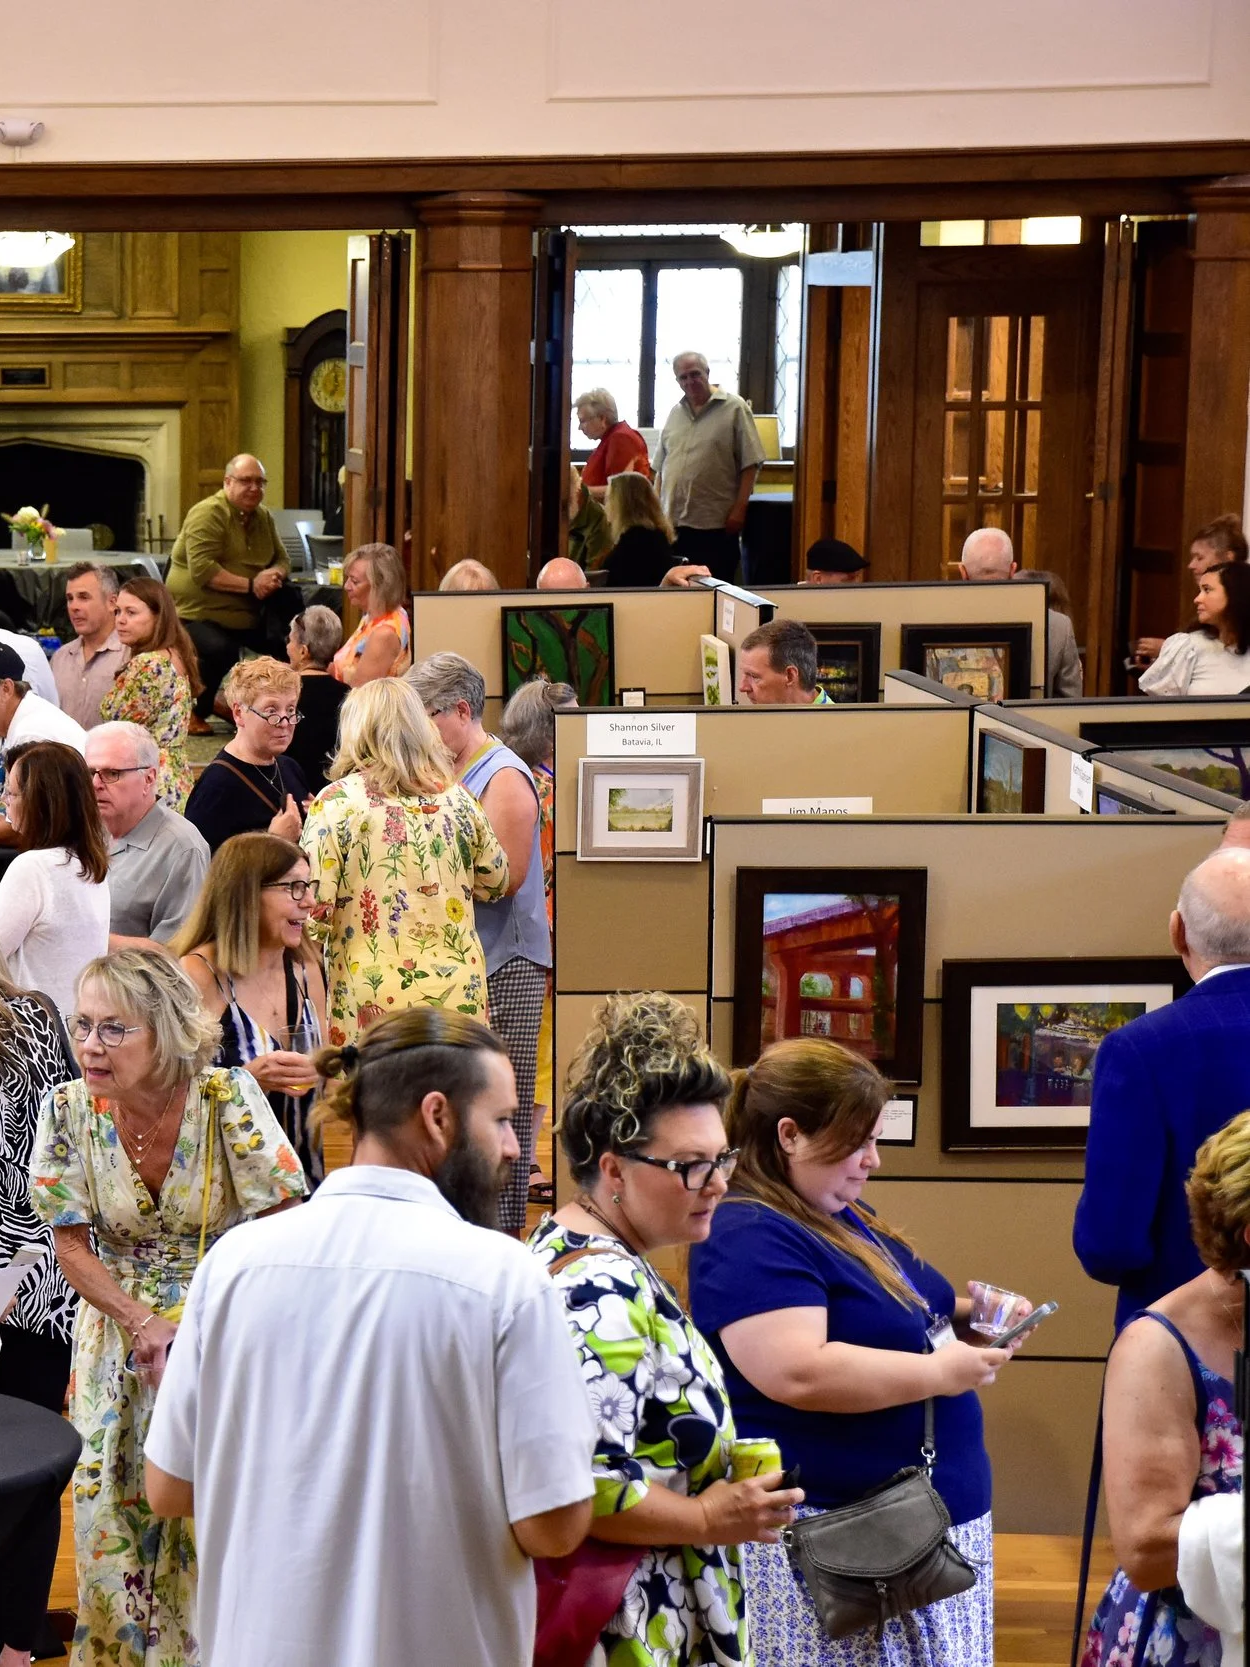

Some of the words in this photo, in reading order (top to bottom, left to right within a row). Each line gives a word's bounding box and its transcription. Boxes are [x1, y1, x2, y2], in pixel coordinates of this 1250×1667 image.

[609, 723, 649, 732] Shannon
[650, 723, 676, 732] Silver
[622, 738, 654, 746] Batavia,
[655, 738, 663, 746] IL
